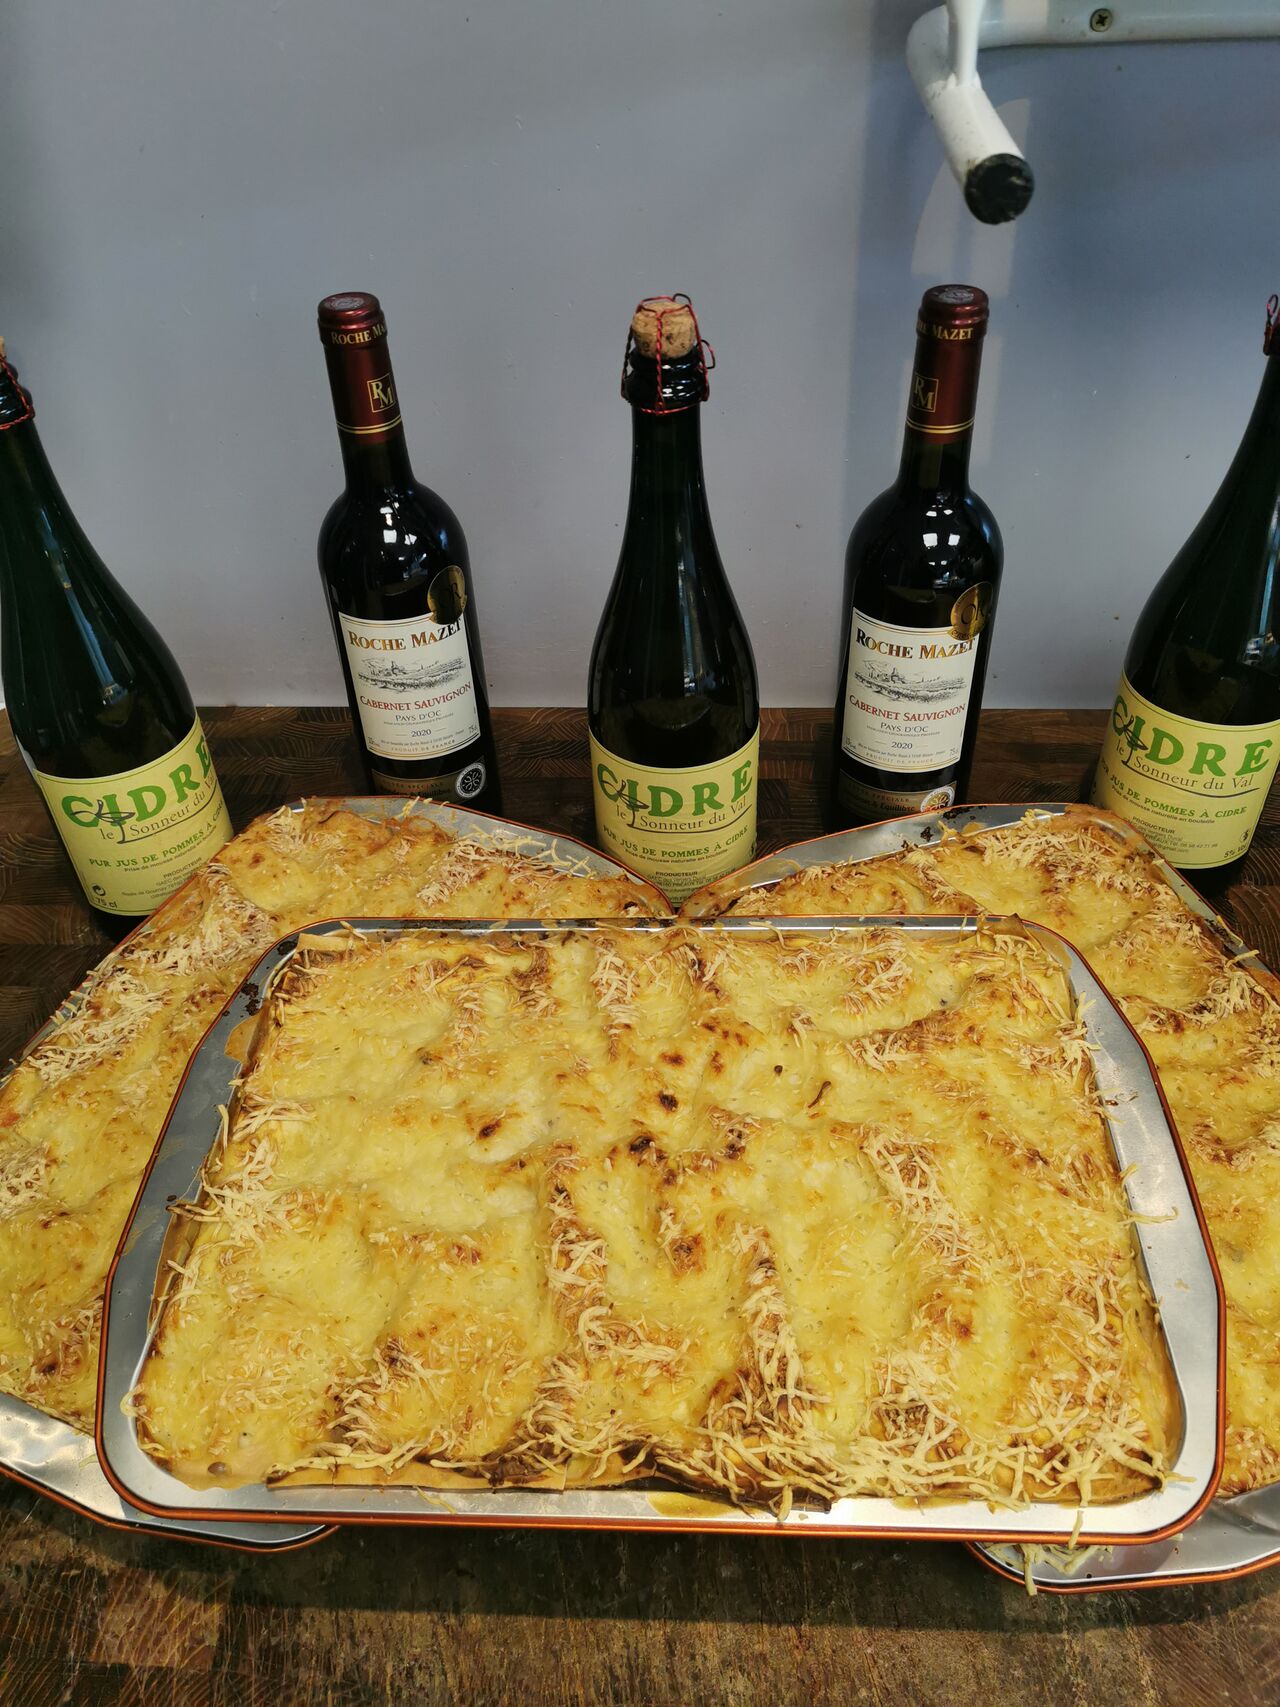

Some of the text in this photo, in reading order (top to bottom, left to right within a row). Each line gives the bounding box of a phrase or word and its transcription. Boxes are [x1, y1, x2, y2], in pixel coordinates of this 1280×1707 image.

[331, 330, 371, 344] ROCHE
[931, 325, 974, 341] MAZET
[348, 617, 463, 651] ROCHE MAZET
[856, 627, 976, 660] ROCHE MAZET
[359, 681, 472, 711] CABERNET SAUVIGNON
[849, 694, 966, 722] CABERNET SAUVIGNON
[395, 714, 416, 722] PAYS
[418, 709, 442, 721] D'OC
[880, 721, 901, 733] PAYS
[904, 725, 929, 733] D'OC
[411, 728, 432, 738] 2020
[891, 741, 913, 750] 2020
[1112, 695, 1273, 777] CIDRE
[1116, 739, 1254, 790] le Sonneur du Val
[61, 735, 212, 828] CIDRE
[597, 760, 752, 817] CIDRE
[1110, 775, 1125, 791] JUS
[1127, 788, 1141, 801] DE
[1144, 797, 1196, 818] POMMES
[1200, 809, 1210, 818] À
[1215, 806, 1248, 819] CIDRE
[100, 828, 115, 840] le
[129, 804, 191, 838] Sonneur
[193, 789, 206, 807] du
[616, 795, 747, 831] le Sonneur du Val
[1132, 816, 1176, 834] PRODUCTEUR
[89, 858, 111, 868] PUR
[115, 858, 138, 867] JUS
[142, 853, 159, 864] DE
[162, 829, 204, 857] POMMES
[603, 824, 618, 842] PUR
[619, 839, 639, 851] JUS
[642, 847, 657, 856] DE
[661, 846, 710, 858] POMMES
[725, 825, 749, 846] CIDRE
[163, 857, 203, 878] PRODUCTEUR
[108, 900, 118, 909] cl
